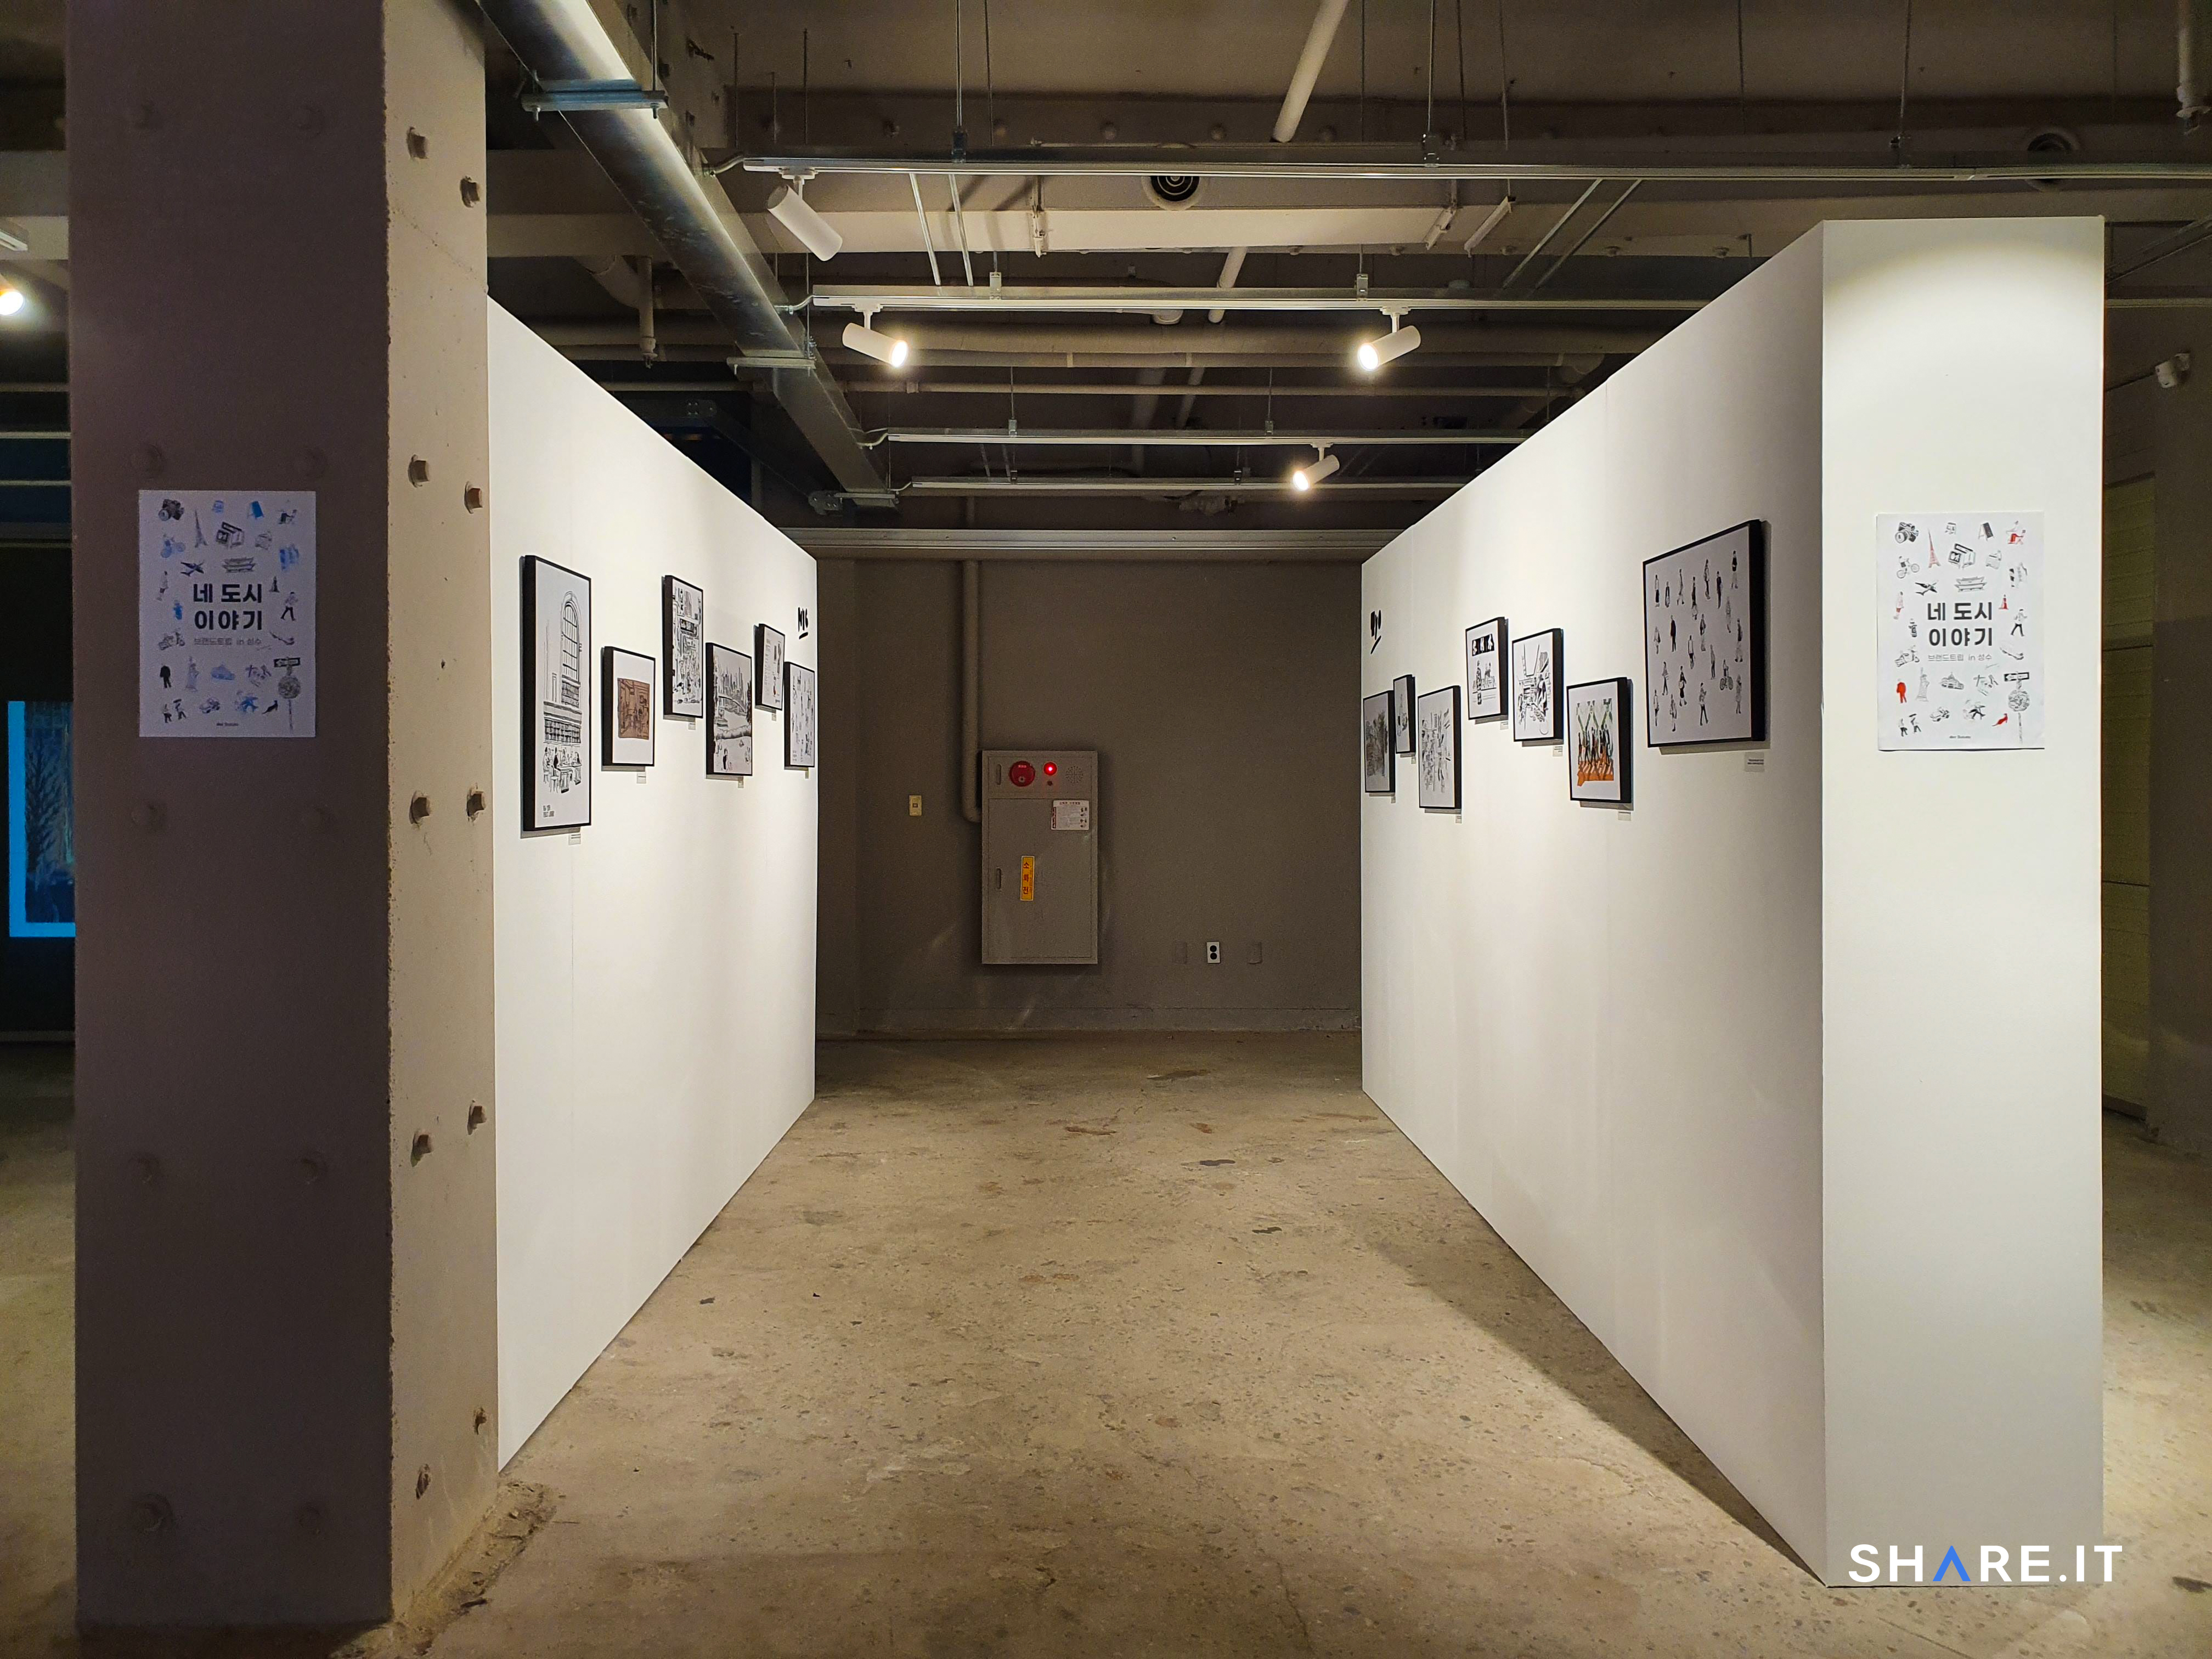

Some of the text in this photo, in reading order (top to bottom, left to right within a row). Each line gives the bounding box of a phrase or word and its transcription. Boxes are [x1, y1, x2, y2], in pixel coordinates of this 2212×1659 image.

[194, 584, 262, 603] 네 도시
[195, 610, 262, 630] 이야기
[1927, 602, 1992, 620] 네 도시
[1929, 628, 1992, 646] 이야기
